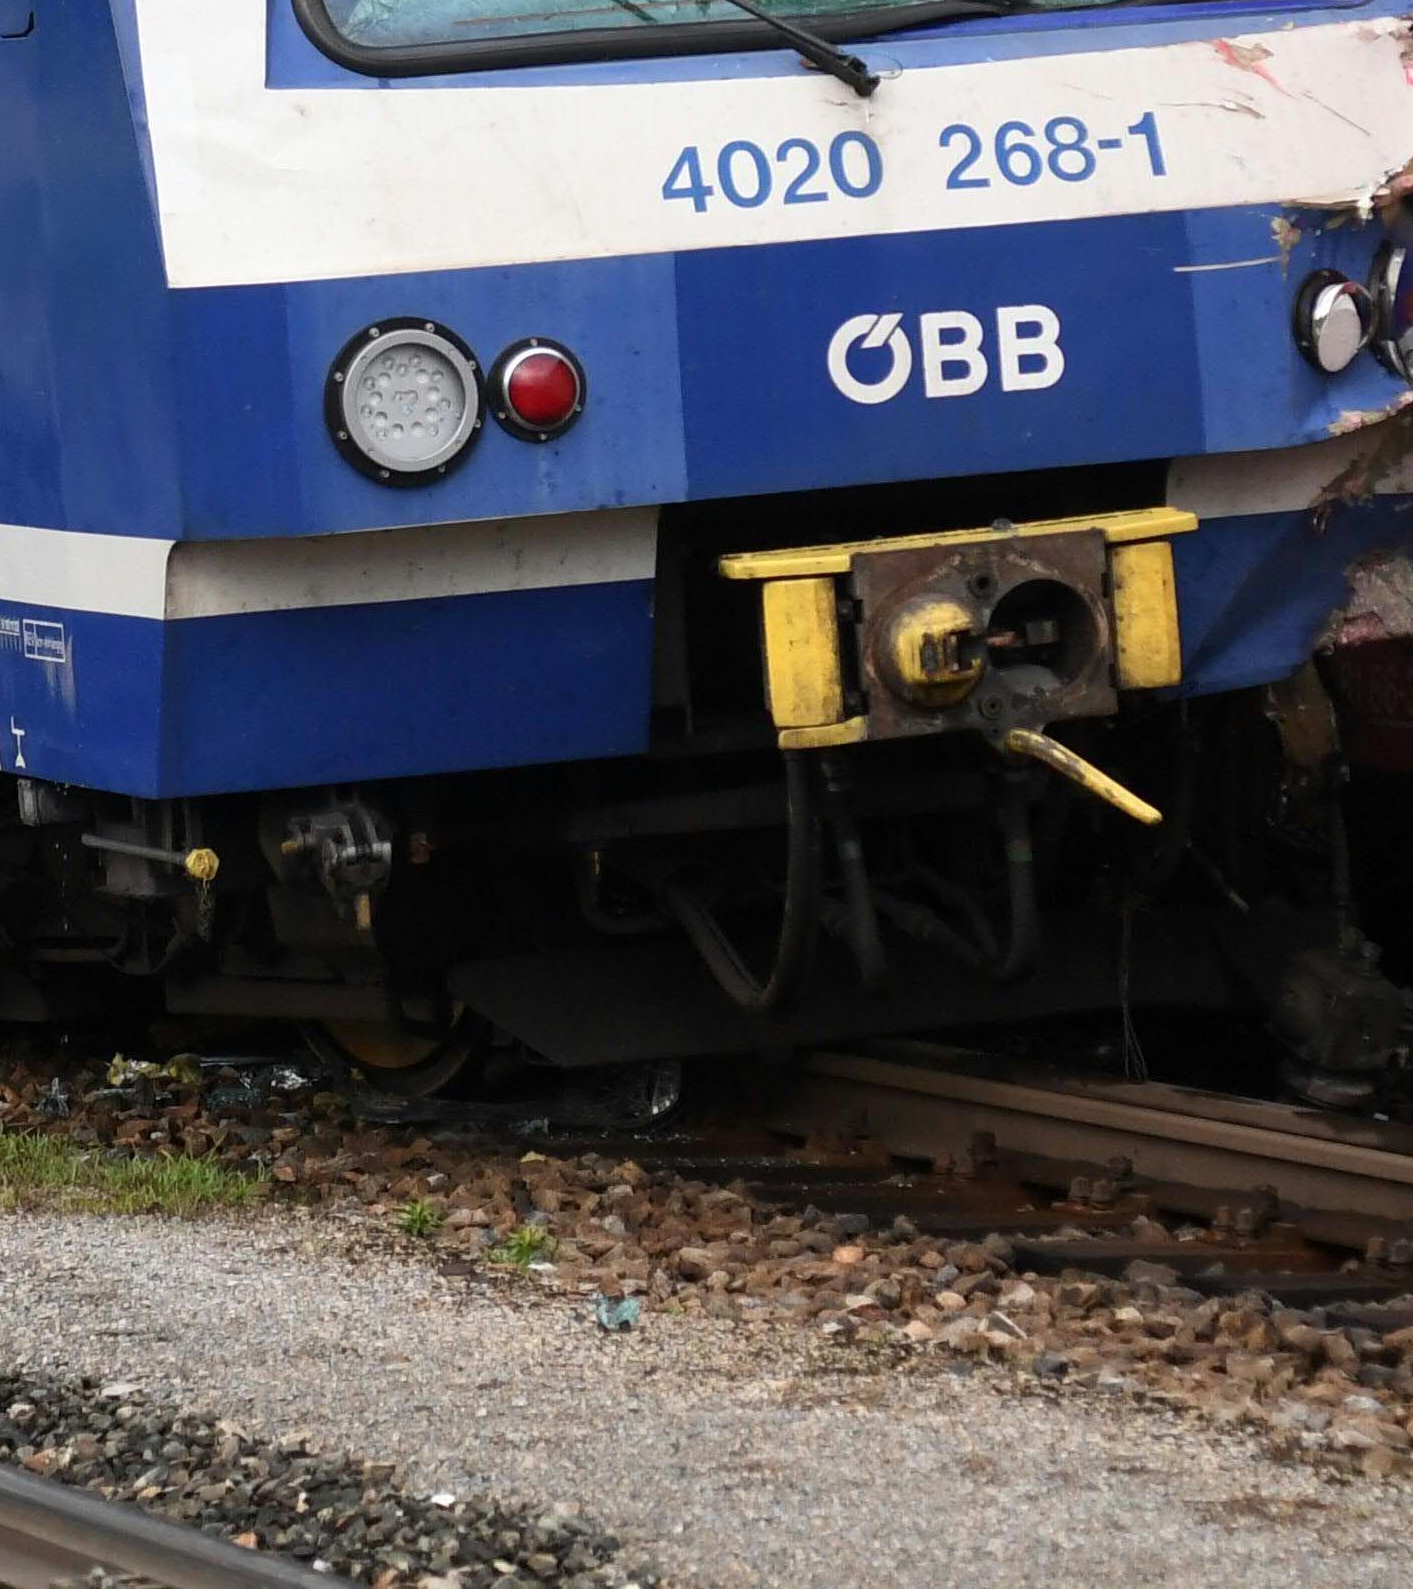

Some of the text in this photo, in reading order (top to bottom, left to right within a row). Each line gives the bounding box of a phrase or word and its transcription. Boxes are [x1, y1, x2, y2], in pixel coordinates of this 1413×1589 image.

[661, 111, 1166, 213] 4020 268-1
[827, 304, 1065, 404] ÖBB
